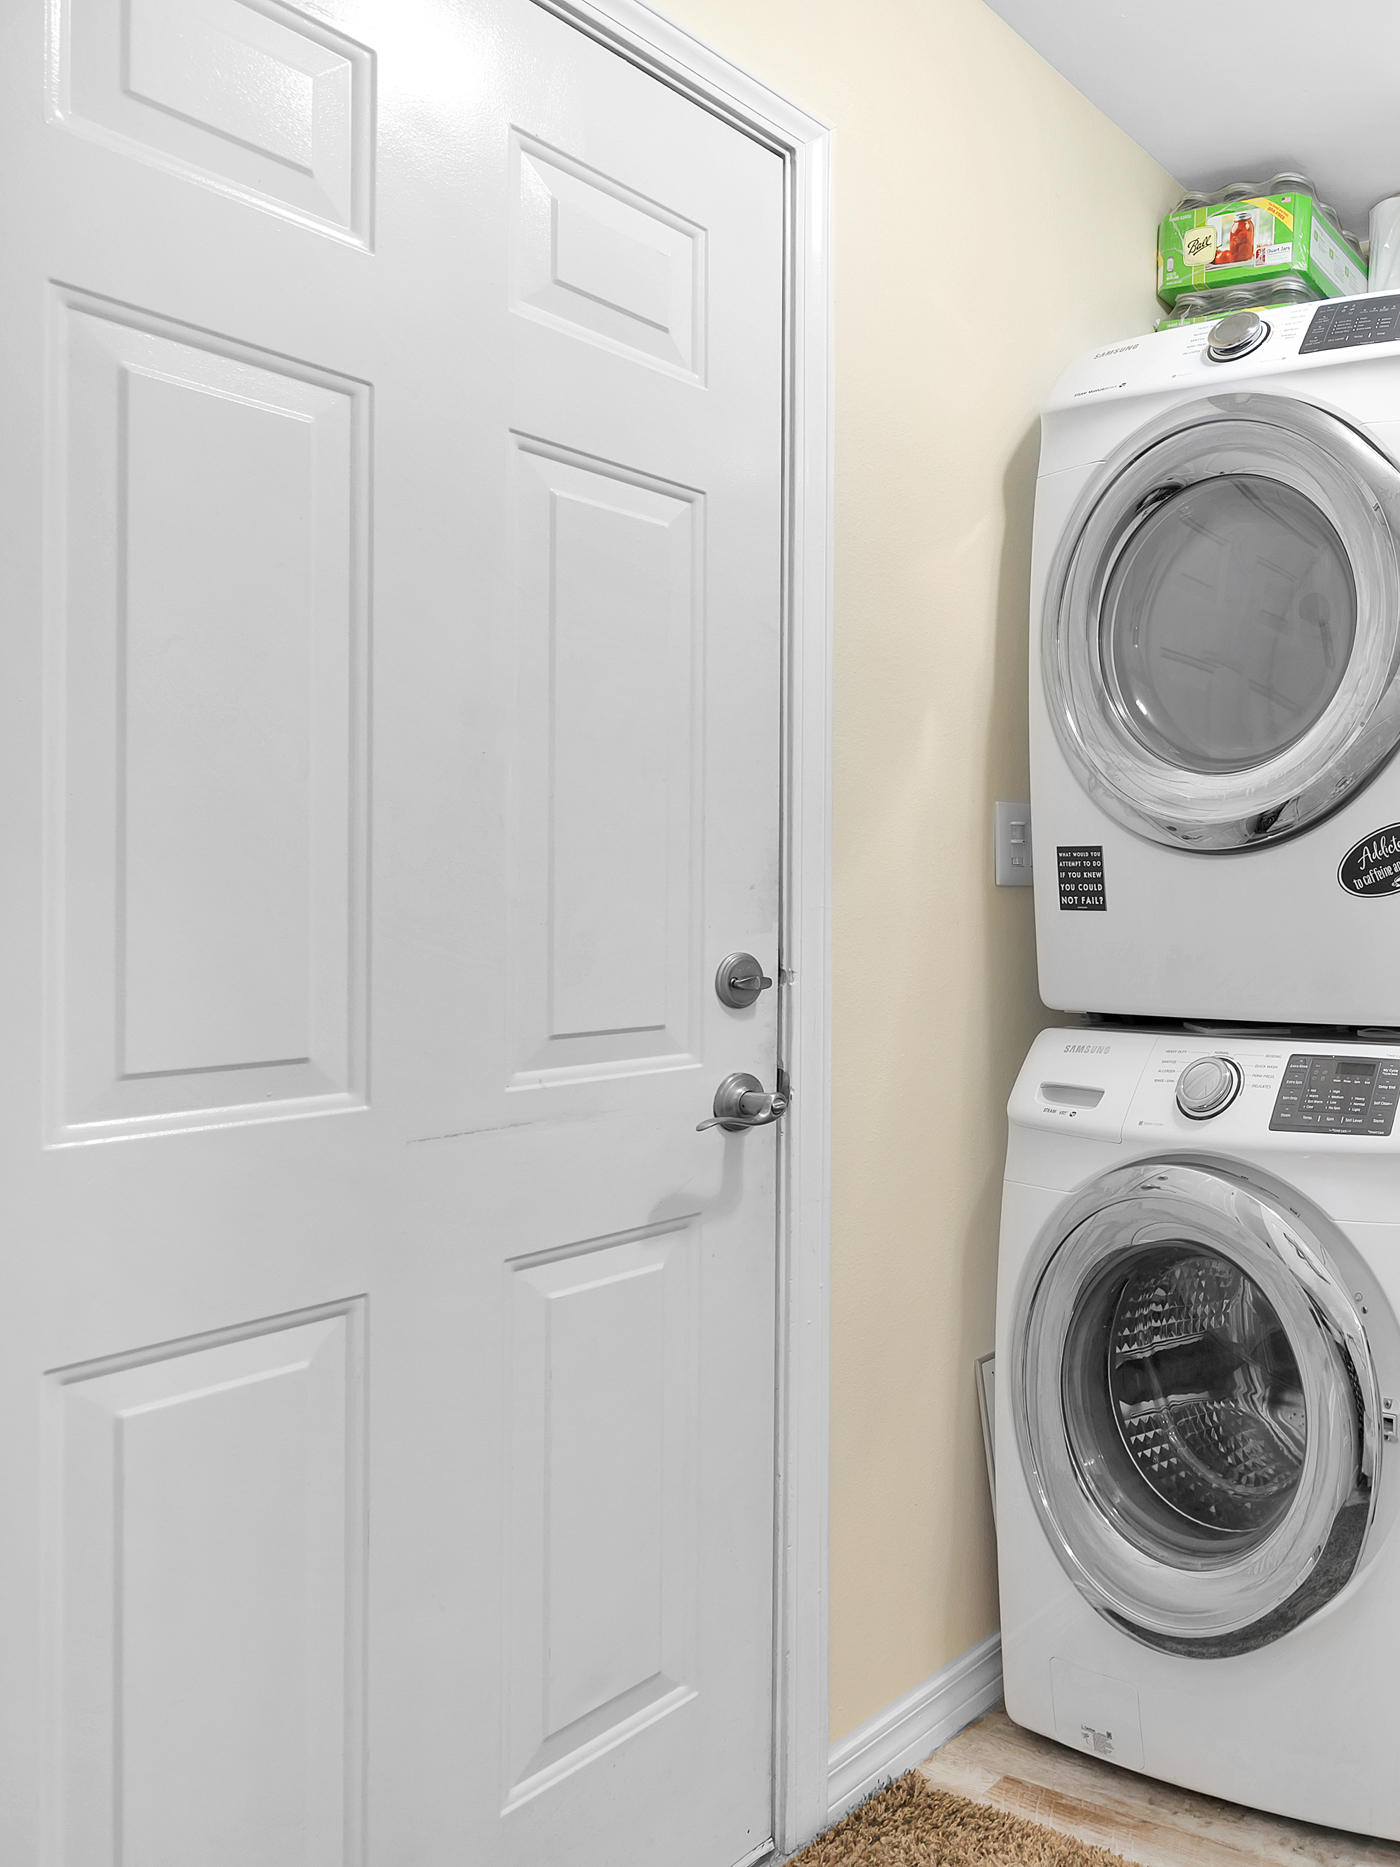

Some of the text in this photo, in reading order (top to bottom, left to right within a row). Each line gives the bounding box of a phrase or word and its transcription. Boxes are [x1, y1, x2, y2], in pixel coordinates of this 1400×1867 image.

[1187, 234, 1212, 256] Ball
[1093, 343, 1140, 360] SAMSUNG
[1353, 878, 1364, 890] to
[1362, 865, 1393, 886] caffeine
[1063, 1044, 1111, 1055] SAMSUNG
